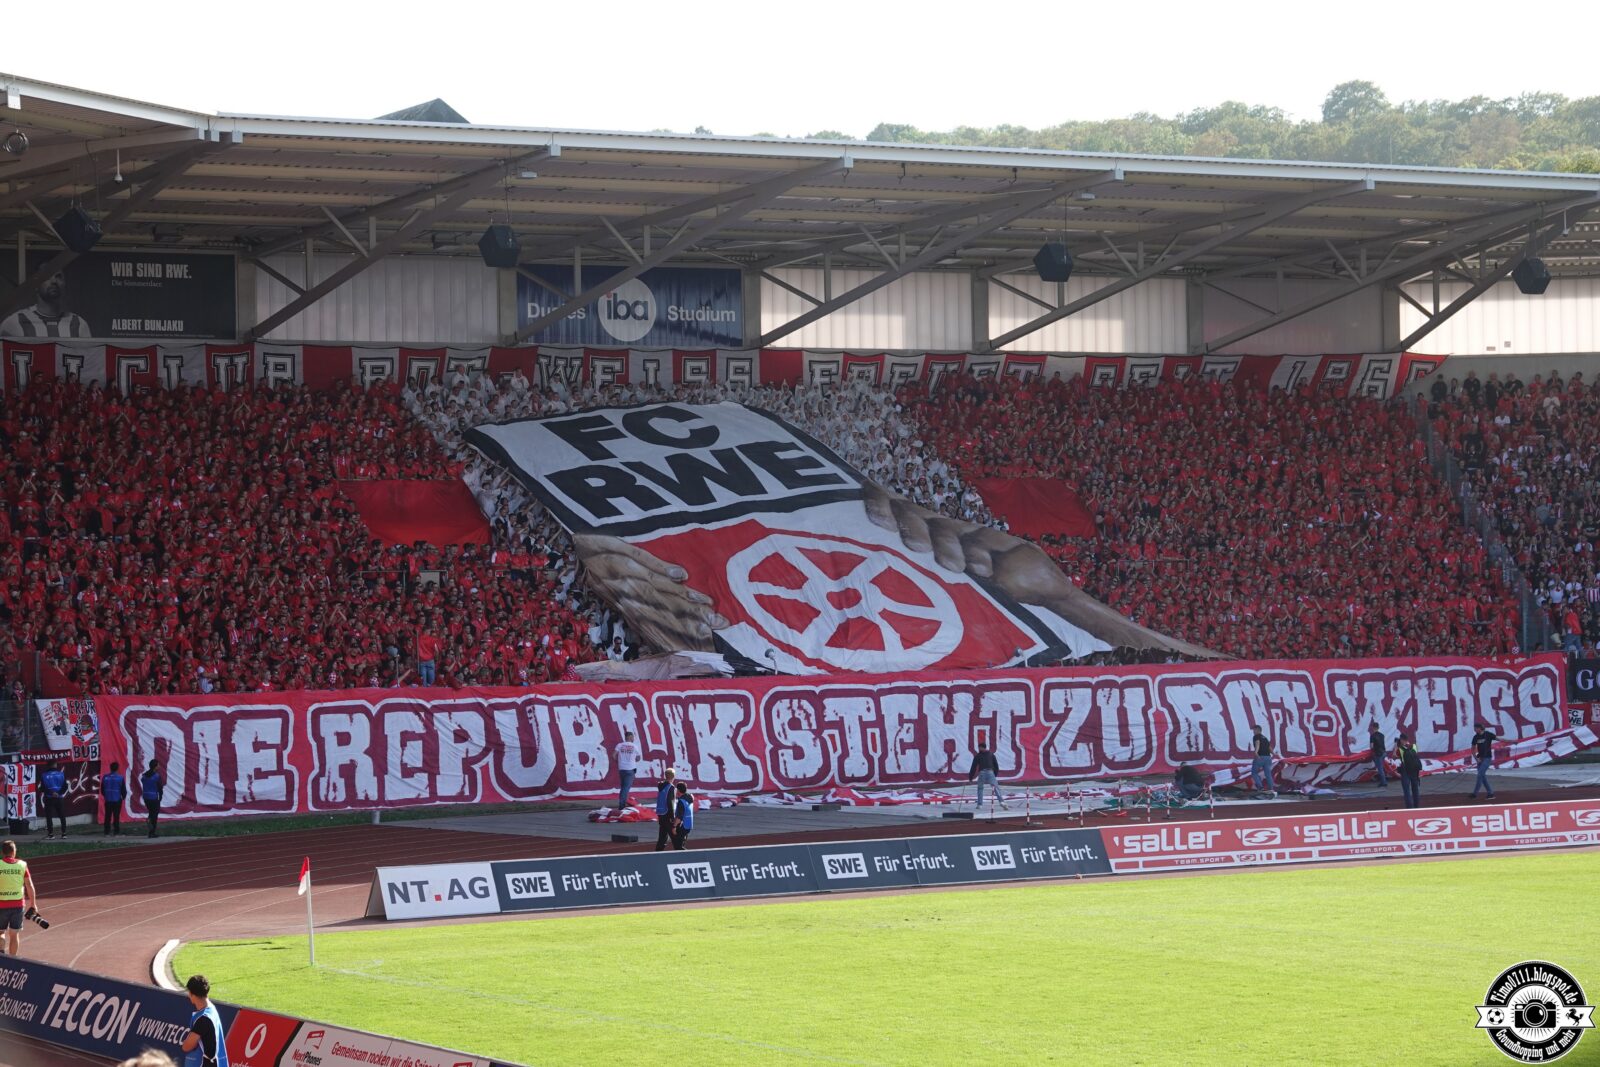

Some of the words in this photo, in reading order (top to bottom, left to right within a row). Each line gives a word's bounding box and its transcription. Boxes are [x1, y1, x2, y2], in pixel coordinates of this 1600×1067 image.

[111, 262, 133, 277] WIR
[137, 263, 162, 278] SIND
[166, 264, 192, 279] RWE.
[527, 303, 586, 320] Dues
[606, 291, 649, 321] iba
[668, 305, 736, 322] Studium
[112, 319, 142, 331] ALBERT
[145, 320, 184, 332] BUNJAKU
[542, 405, 720, 462] FC
[544, 440, 848, 518] RWE
[1576, 669, 1600, 690] G
[130, 712, 292, 810] DIE
[314, 697, 762, 804] REPUBLIK
[770, 685, 1032, 784] STEHT
[1045, 682, 1151, 773] ZU
[1161, 670, 1560, 762] ROT-WEISS
[827, 857, 864, 876] SWE
[874, 855, 899, 872] Für
[903, 852, 955, 870] Erfurt.
[976, 849, 1011, 867] SWE
[1021, 847, 1046, 863] Für
[1051, 844, 1098, 862] Erfurt.
[511, 876, 549, 895] SWE
[562, 873, 590, 892] Für
[594, 870, 649, 890] Erfurt.
[673, 866, 710, 885] SWE
[721, 864, 748, 881] Für
[753, 861, 805, 880] Erfurt.
[8, 968, 28, 991] FÜR
[40, 983, 141, 1044] TECCON
[331, 1041, 369, 1062] Gemeinsam
[367, 1050, 391, 1067] rocken
